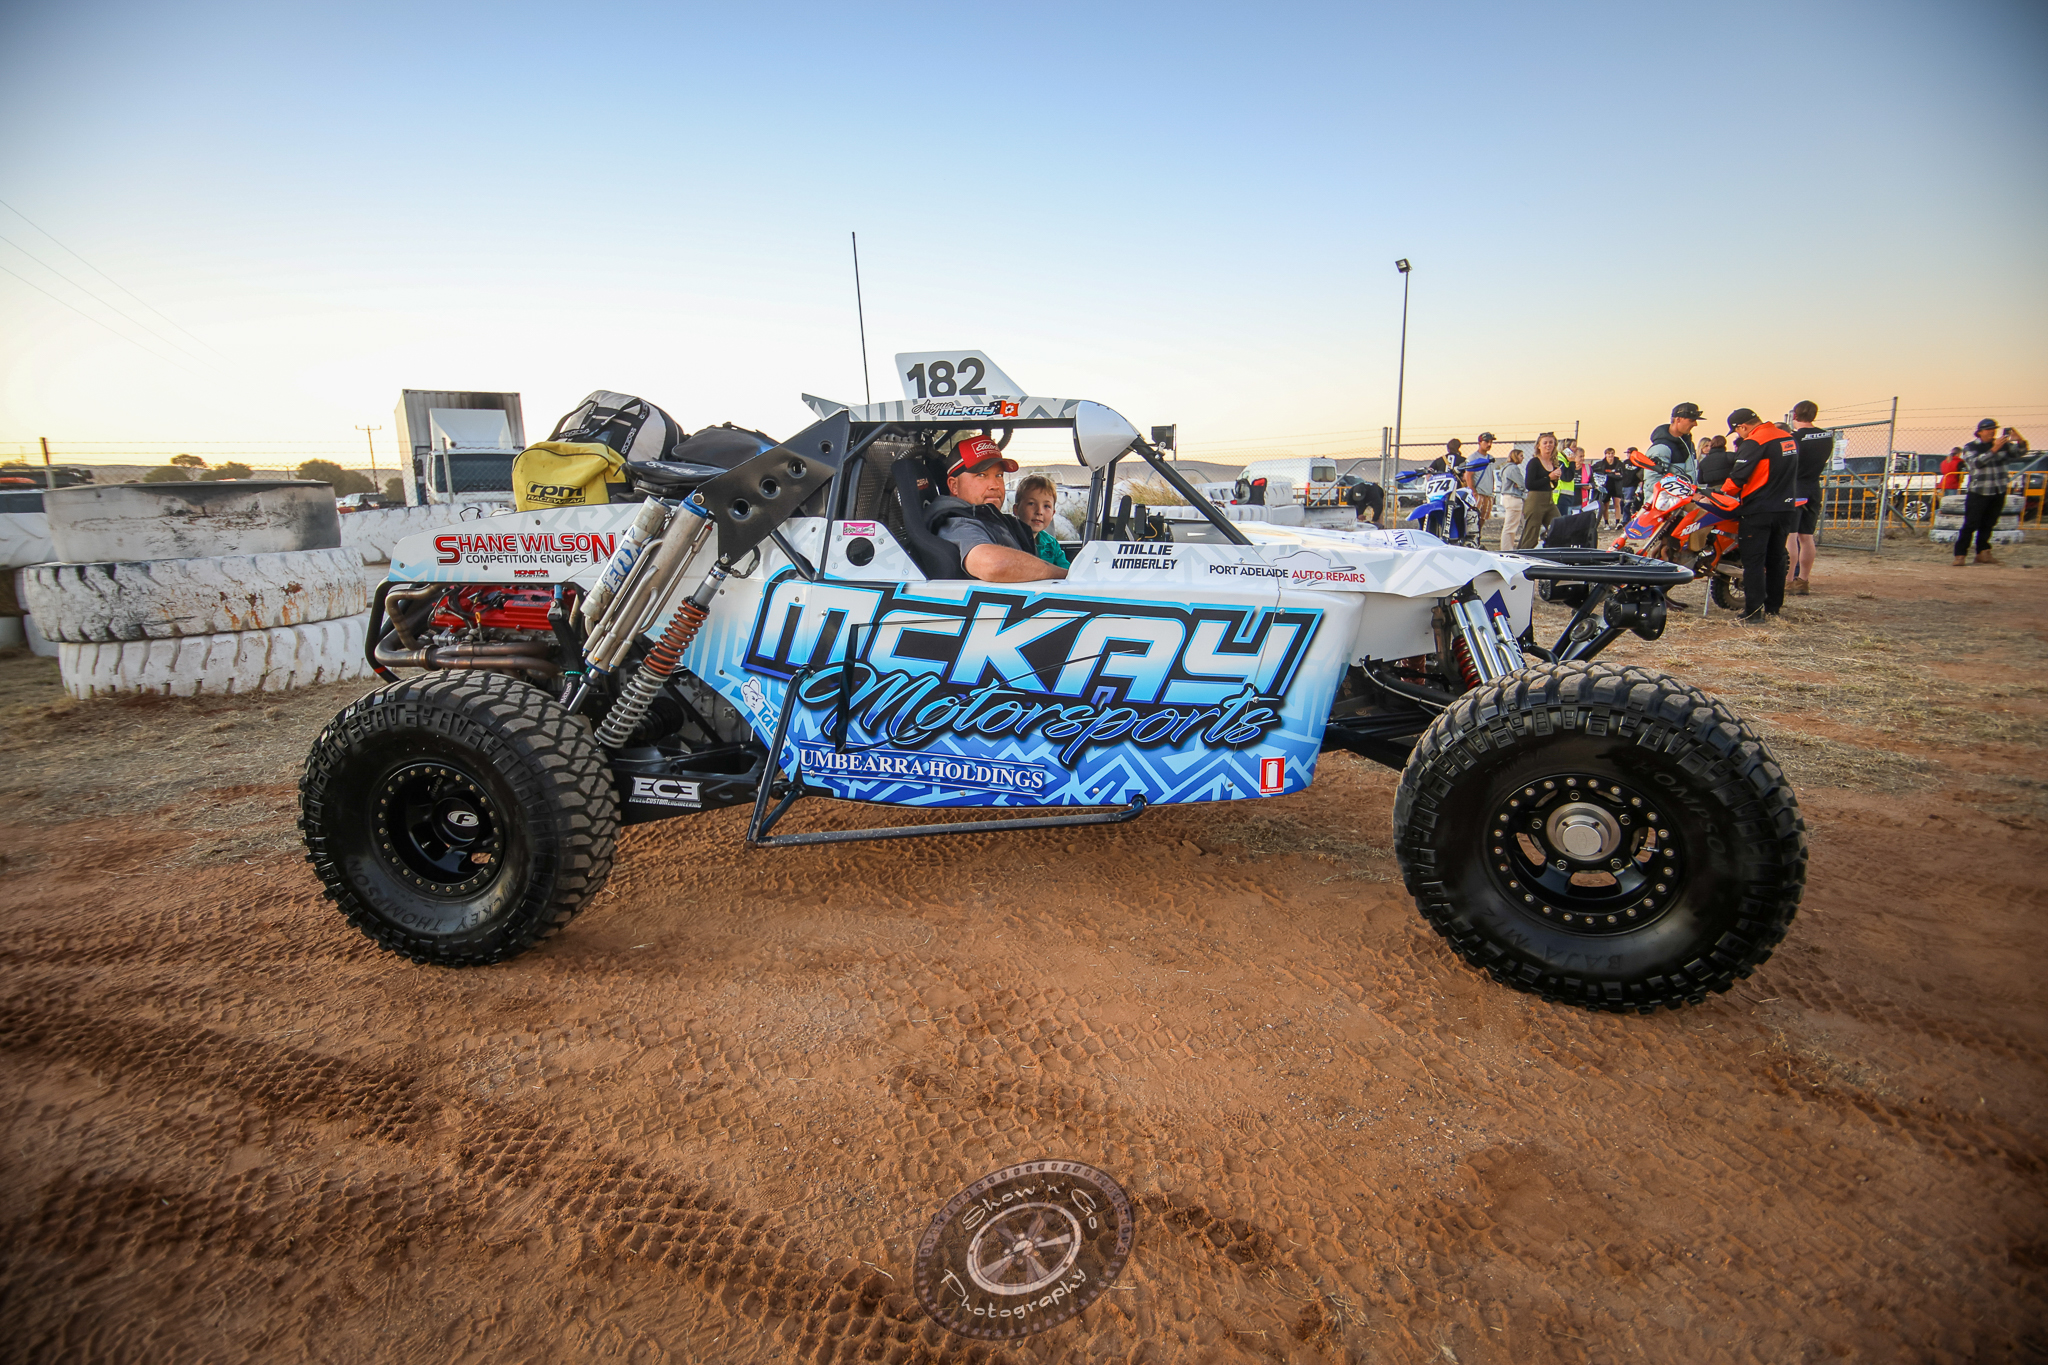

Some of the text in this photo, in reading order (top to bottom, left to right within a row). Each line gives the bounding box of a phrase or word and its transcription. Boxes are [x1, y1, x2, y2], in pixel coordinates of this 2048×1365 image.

[907, 357, 986, 398] 182
[912, 399, 954, 415] Angus
[530, 484, 583, 497] rpm
[1427, 480, 1452, 495] 574
[433, 533, 616, 566] SHANE WILSON
[1117, 544, 1173, 556] MILLIE
[466, 555, 588, 564] COMPETITION ENGINES
[1111, 558, 1177, 570] KIMBERLEY
[1209, 564, 1366, 583] PORT ADELAIDE AUTO REPAIRS
[798, 662, 1280, 765] Motorsports
[800, 749, 1044, 788] UMBEARRA HOLDINGS
